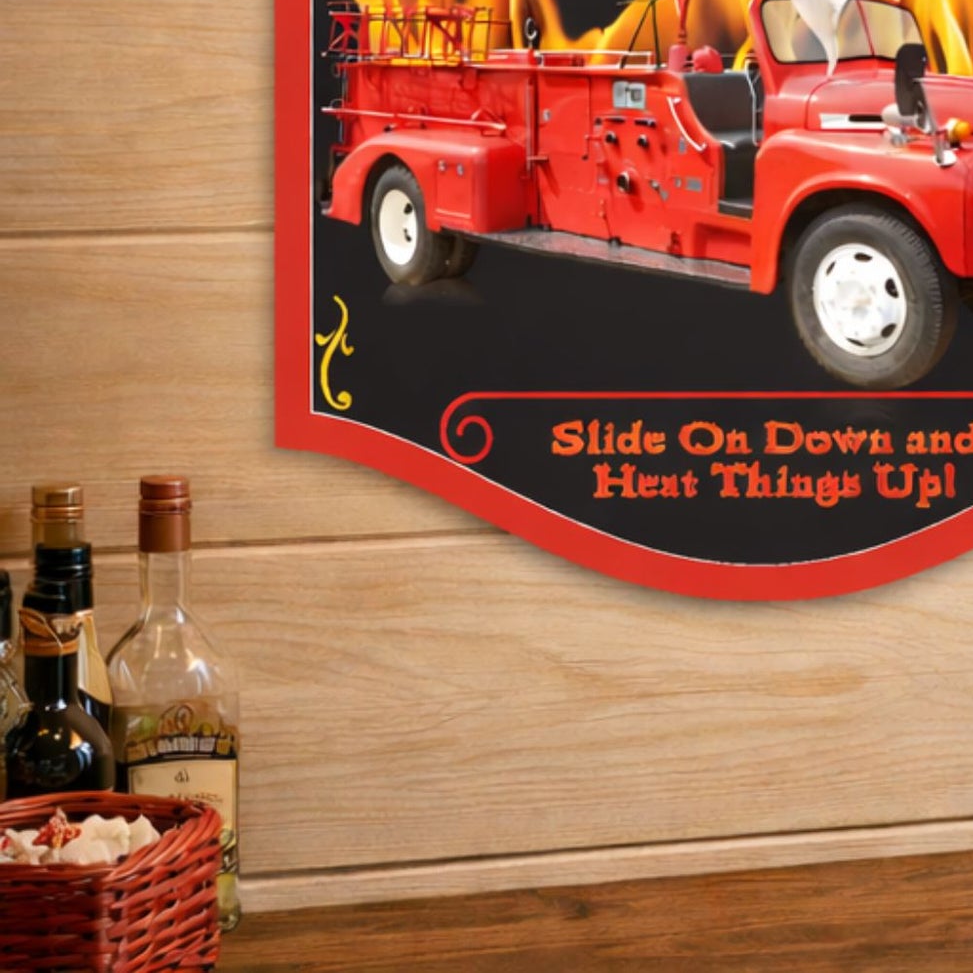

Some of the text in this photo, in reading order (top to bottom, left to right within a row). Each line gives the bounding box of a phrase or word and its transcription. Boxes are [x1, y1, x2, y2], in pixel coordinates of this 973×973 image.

[551, 420, 666, 455] Slide
[678, 421, 752, 455] On
[764, 420, 894, 455] Down
[592, 460, 957, 508] Heat Things Up!
